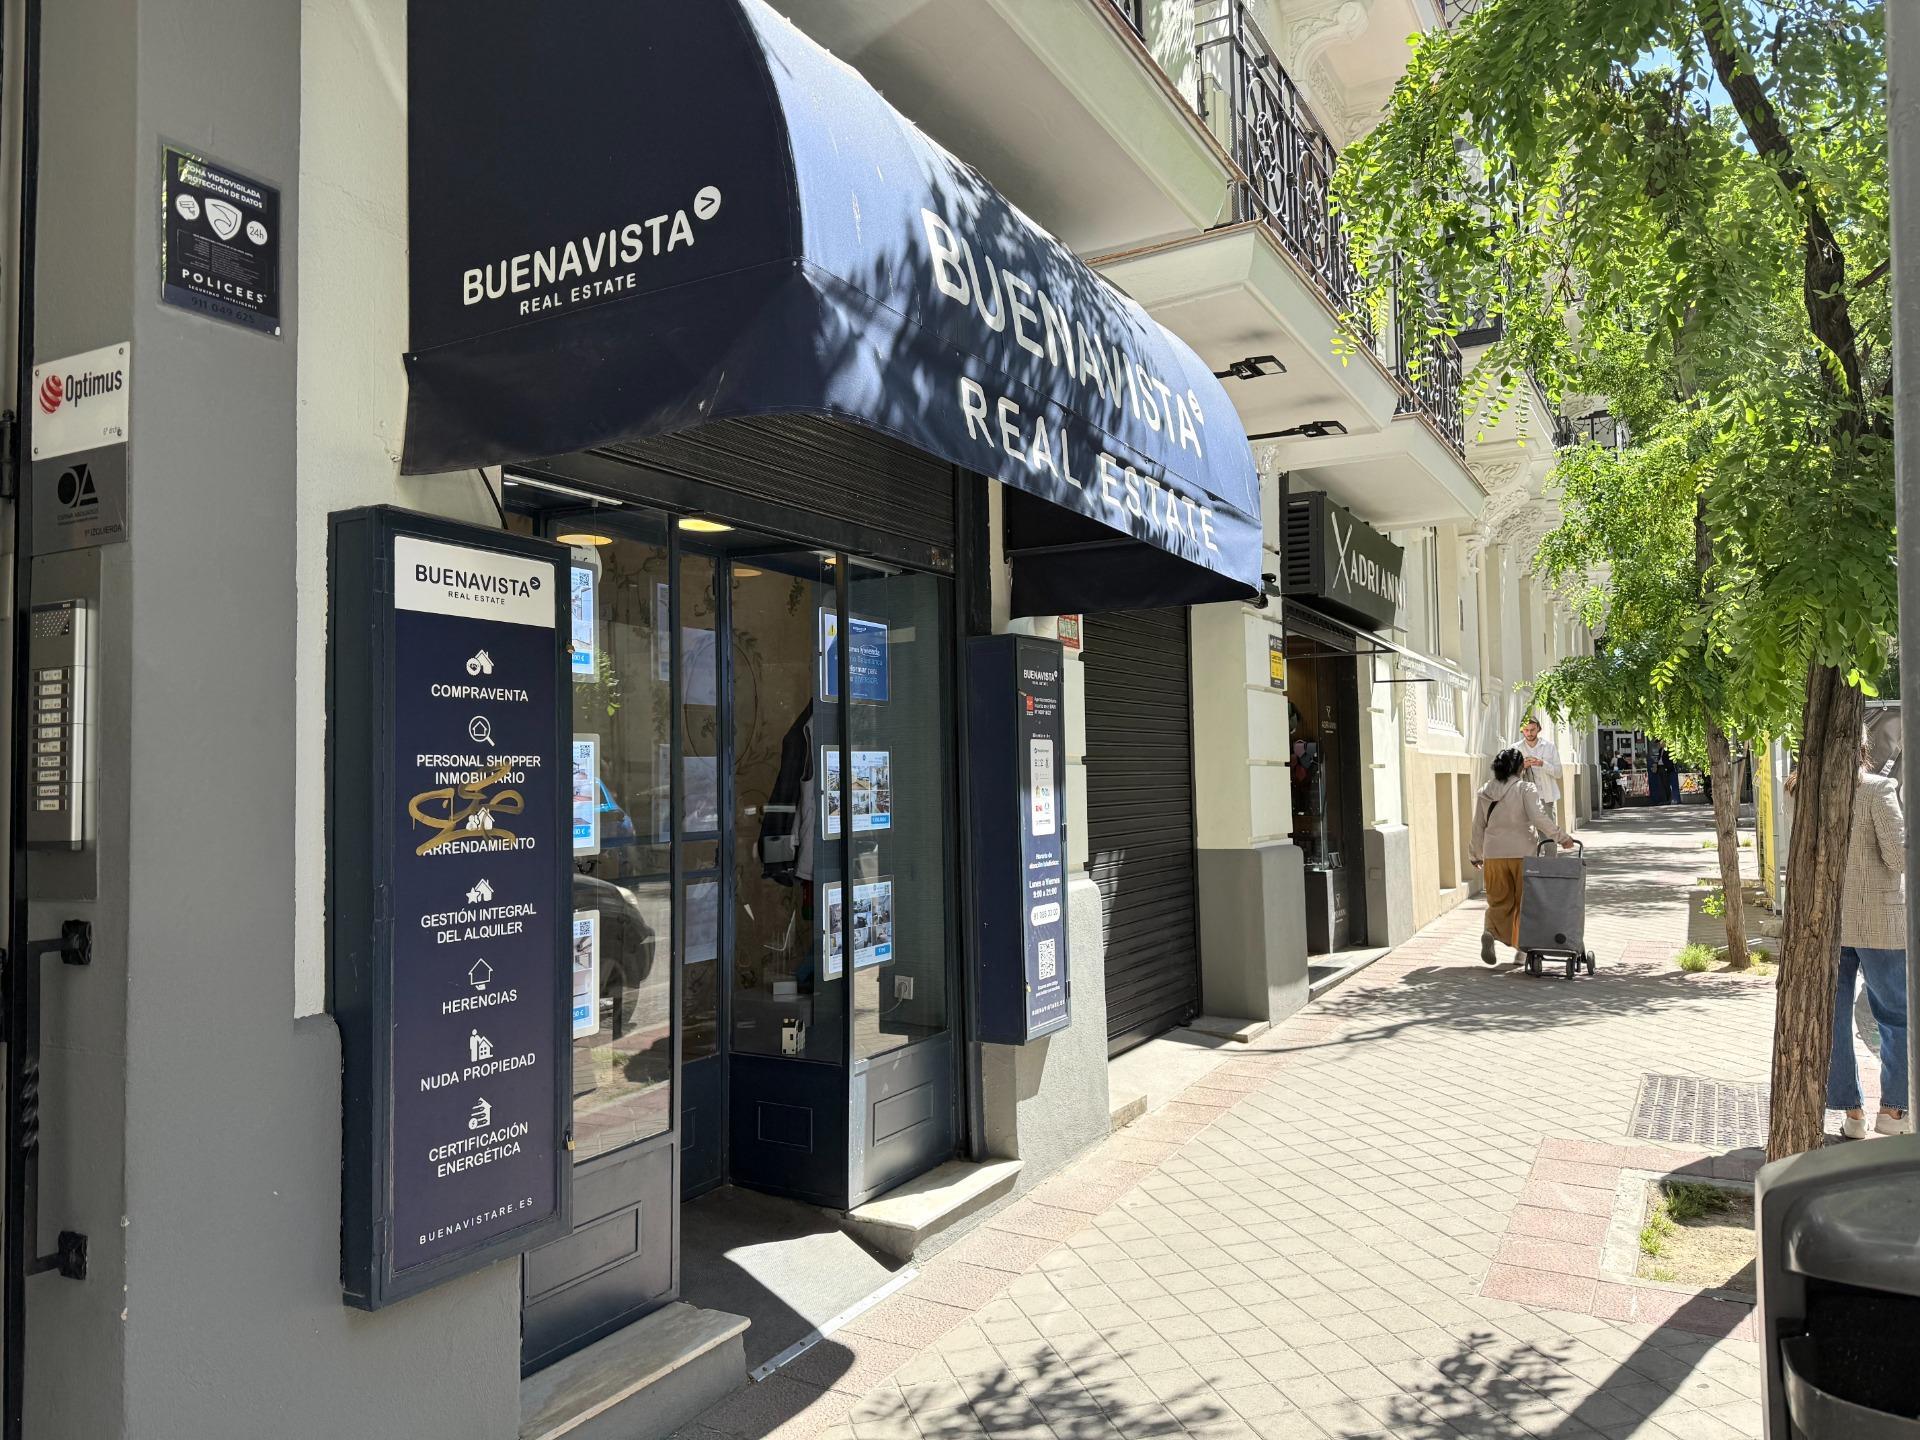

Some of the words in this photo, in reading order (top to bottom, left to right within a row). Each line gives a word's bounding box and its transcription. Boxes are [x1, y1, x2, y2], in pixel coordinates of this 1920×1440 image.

[185, 173, 229, 196] PROTECCIÓN
[230, 189, 240, 200] DE
[241, 194, 263, 209] DATOS
[207, 171, 261, 199] VIDEOVIGILADA
[249, 226, 265, 240] 24h
[464, 210, 695, 306] BUENAVISTA
[182, 268, 264, 304] POLICEES
[520, 293, 563, 317] REAL
[570, 272, 637, 304] ESTATE
[921, 207, 1203, 458] BUENAVISTA
[65, 370, 123, 408] Optimus
[961, 376, 1083, 491] REAL
[1099, 451, 1219, 553] ESTATE
[415, 563, 530, 598] BUENAVISTA
[448, 590, 471, 601] REAL
[474, 594, 506, 605] ESTATE
[431, 683, 529, 702] COMPRAVENTA
[416, 754, 484, 767] PERSONAL
[486, 755, 541, 767] SHOPPER
[435, 771, 525, 785] INMOBIRIO
[420, 908, 477, 928] GESTIÓN
[479, 903, 537, 921] INTEGRAL
[437, 930, 462, 944] DEL
[464, 921, 523, 940] ALQUILER
[442, 989, 518, 1015] HERENCIAS
[420, 1071, 460, 1092] NUDA
[463, 1052, 536, 1082] PROPIEDAD
[428, 1121, 529, 1162] CERTIFICACIÓN
[437, 1141, 521, 1178] ENERGÉTICA
